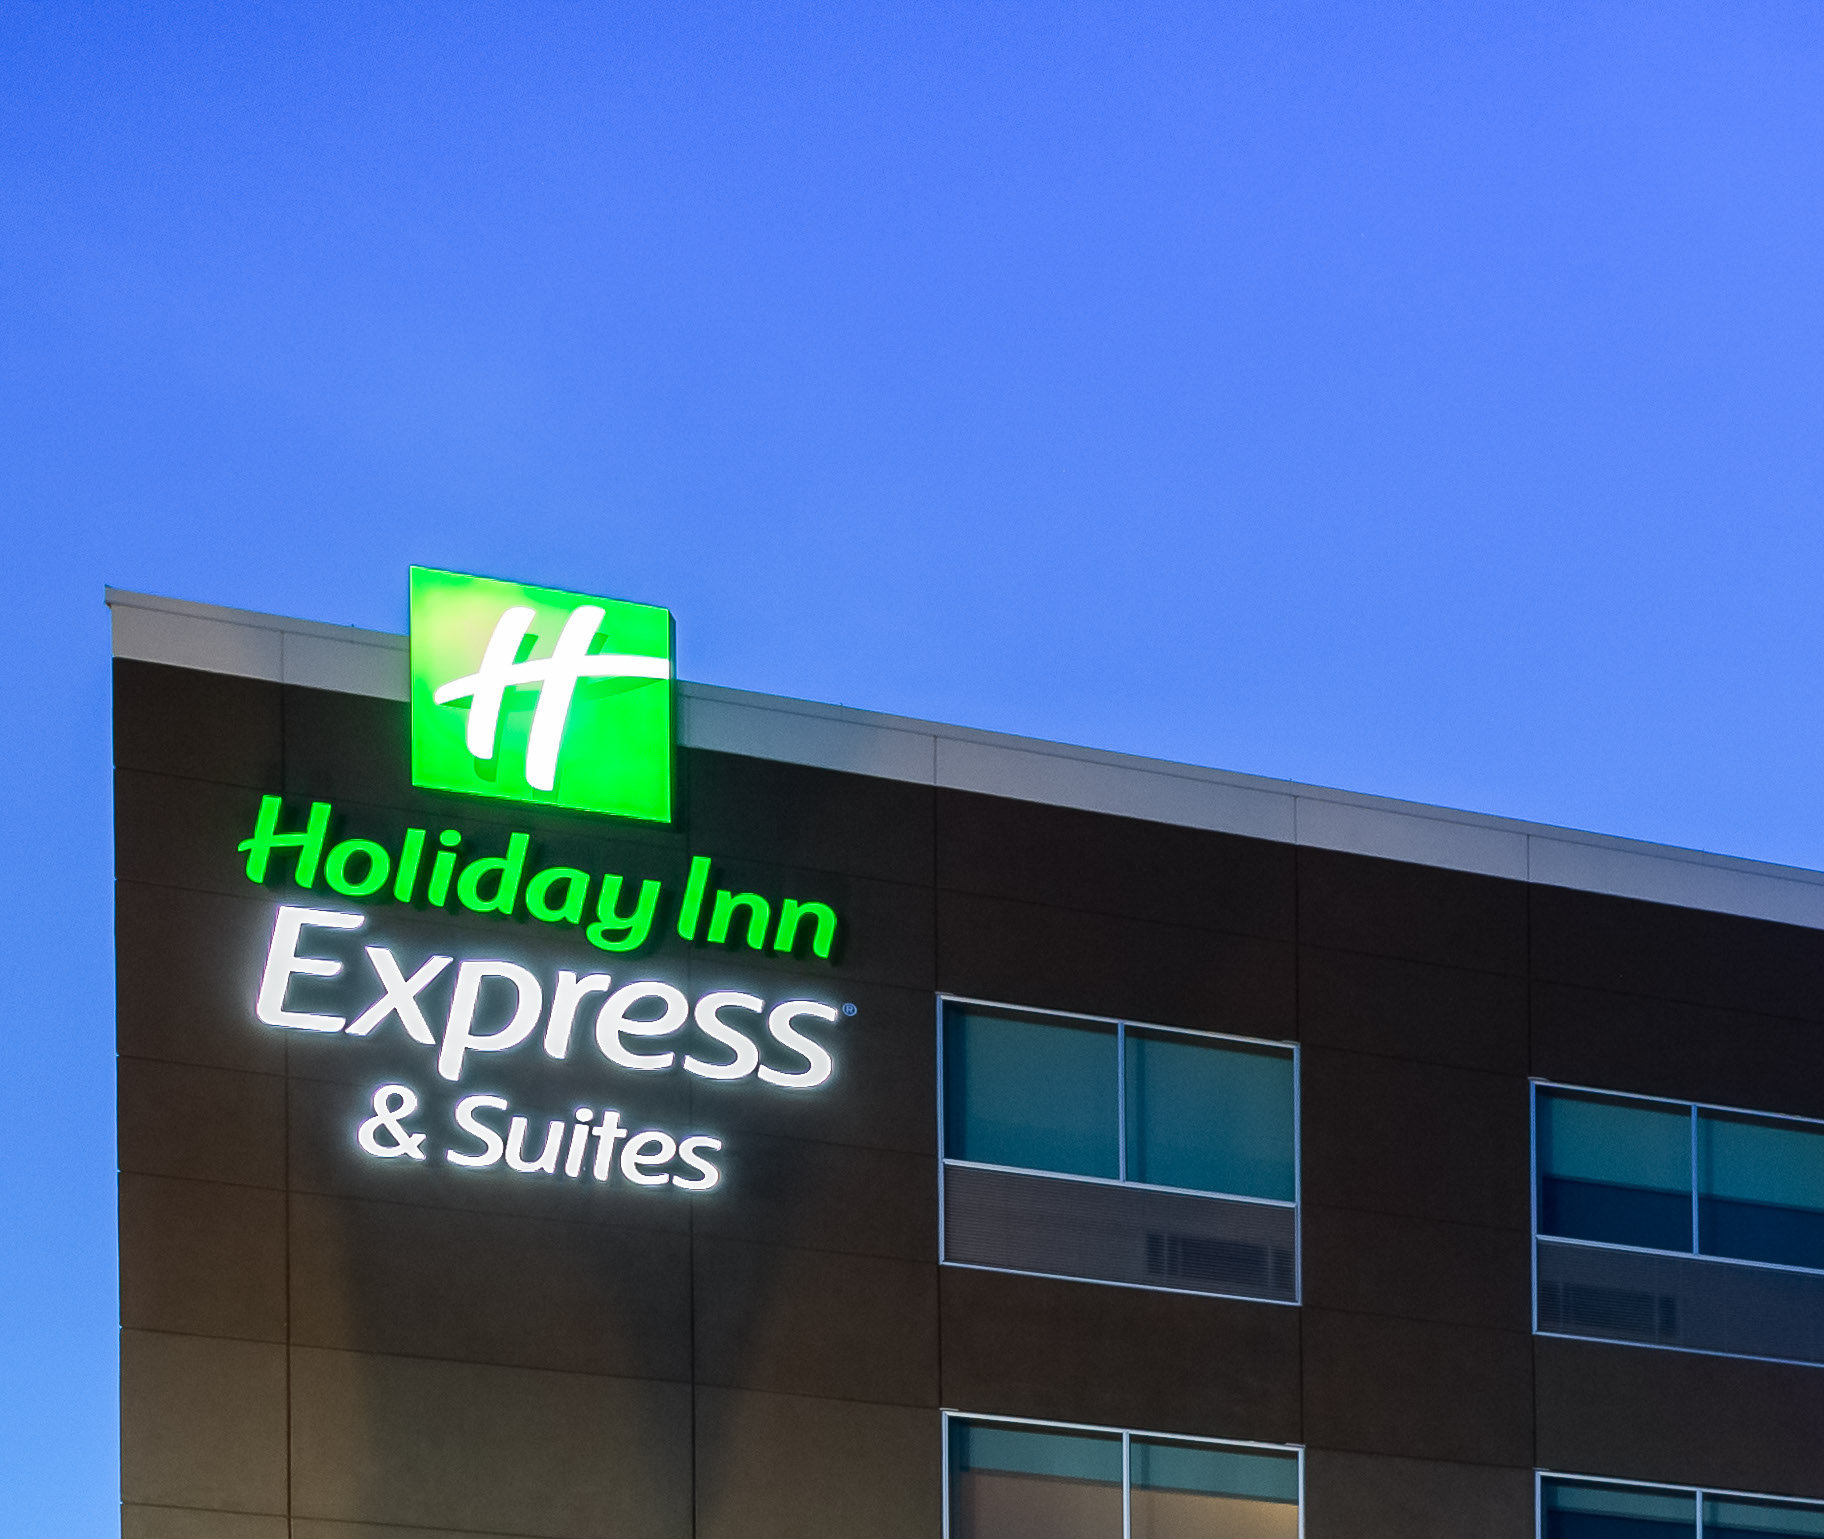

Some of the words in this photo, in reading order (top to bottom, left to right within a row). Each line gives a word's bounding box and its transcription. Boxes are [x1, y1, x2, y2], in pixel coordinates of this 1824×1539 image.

[434, 605, 670, 791] H
[238, 794, 662, 953] Holiday
[676, 855, 838, 959] Inn
[255, 904, 838, 1089] Express
[358, 1083, 426, 1160] &
[447, 1094, 722, 1192] Suites
